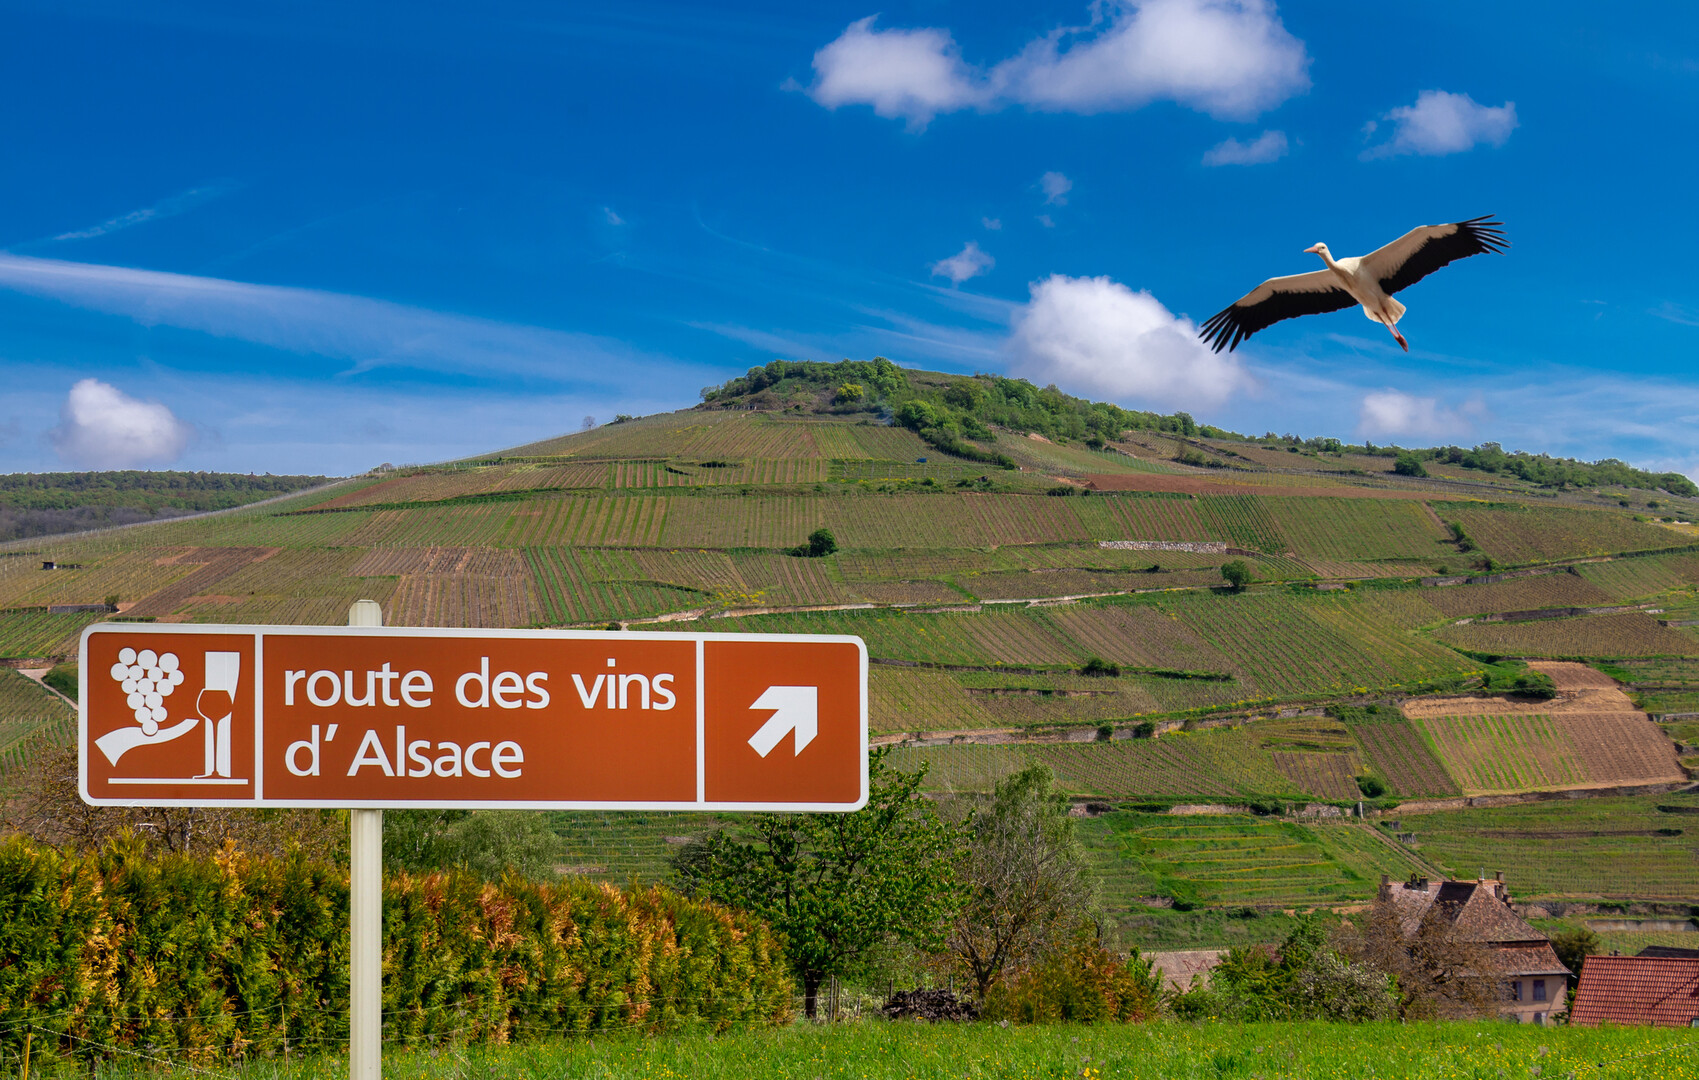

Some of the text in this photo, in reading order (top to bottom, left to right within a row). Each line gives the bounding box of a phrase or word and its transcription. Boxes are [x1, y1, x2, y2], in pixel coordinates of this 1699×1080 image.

[284, 656, 677, 711] route des vins
